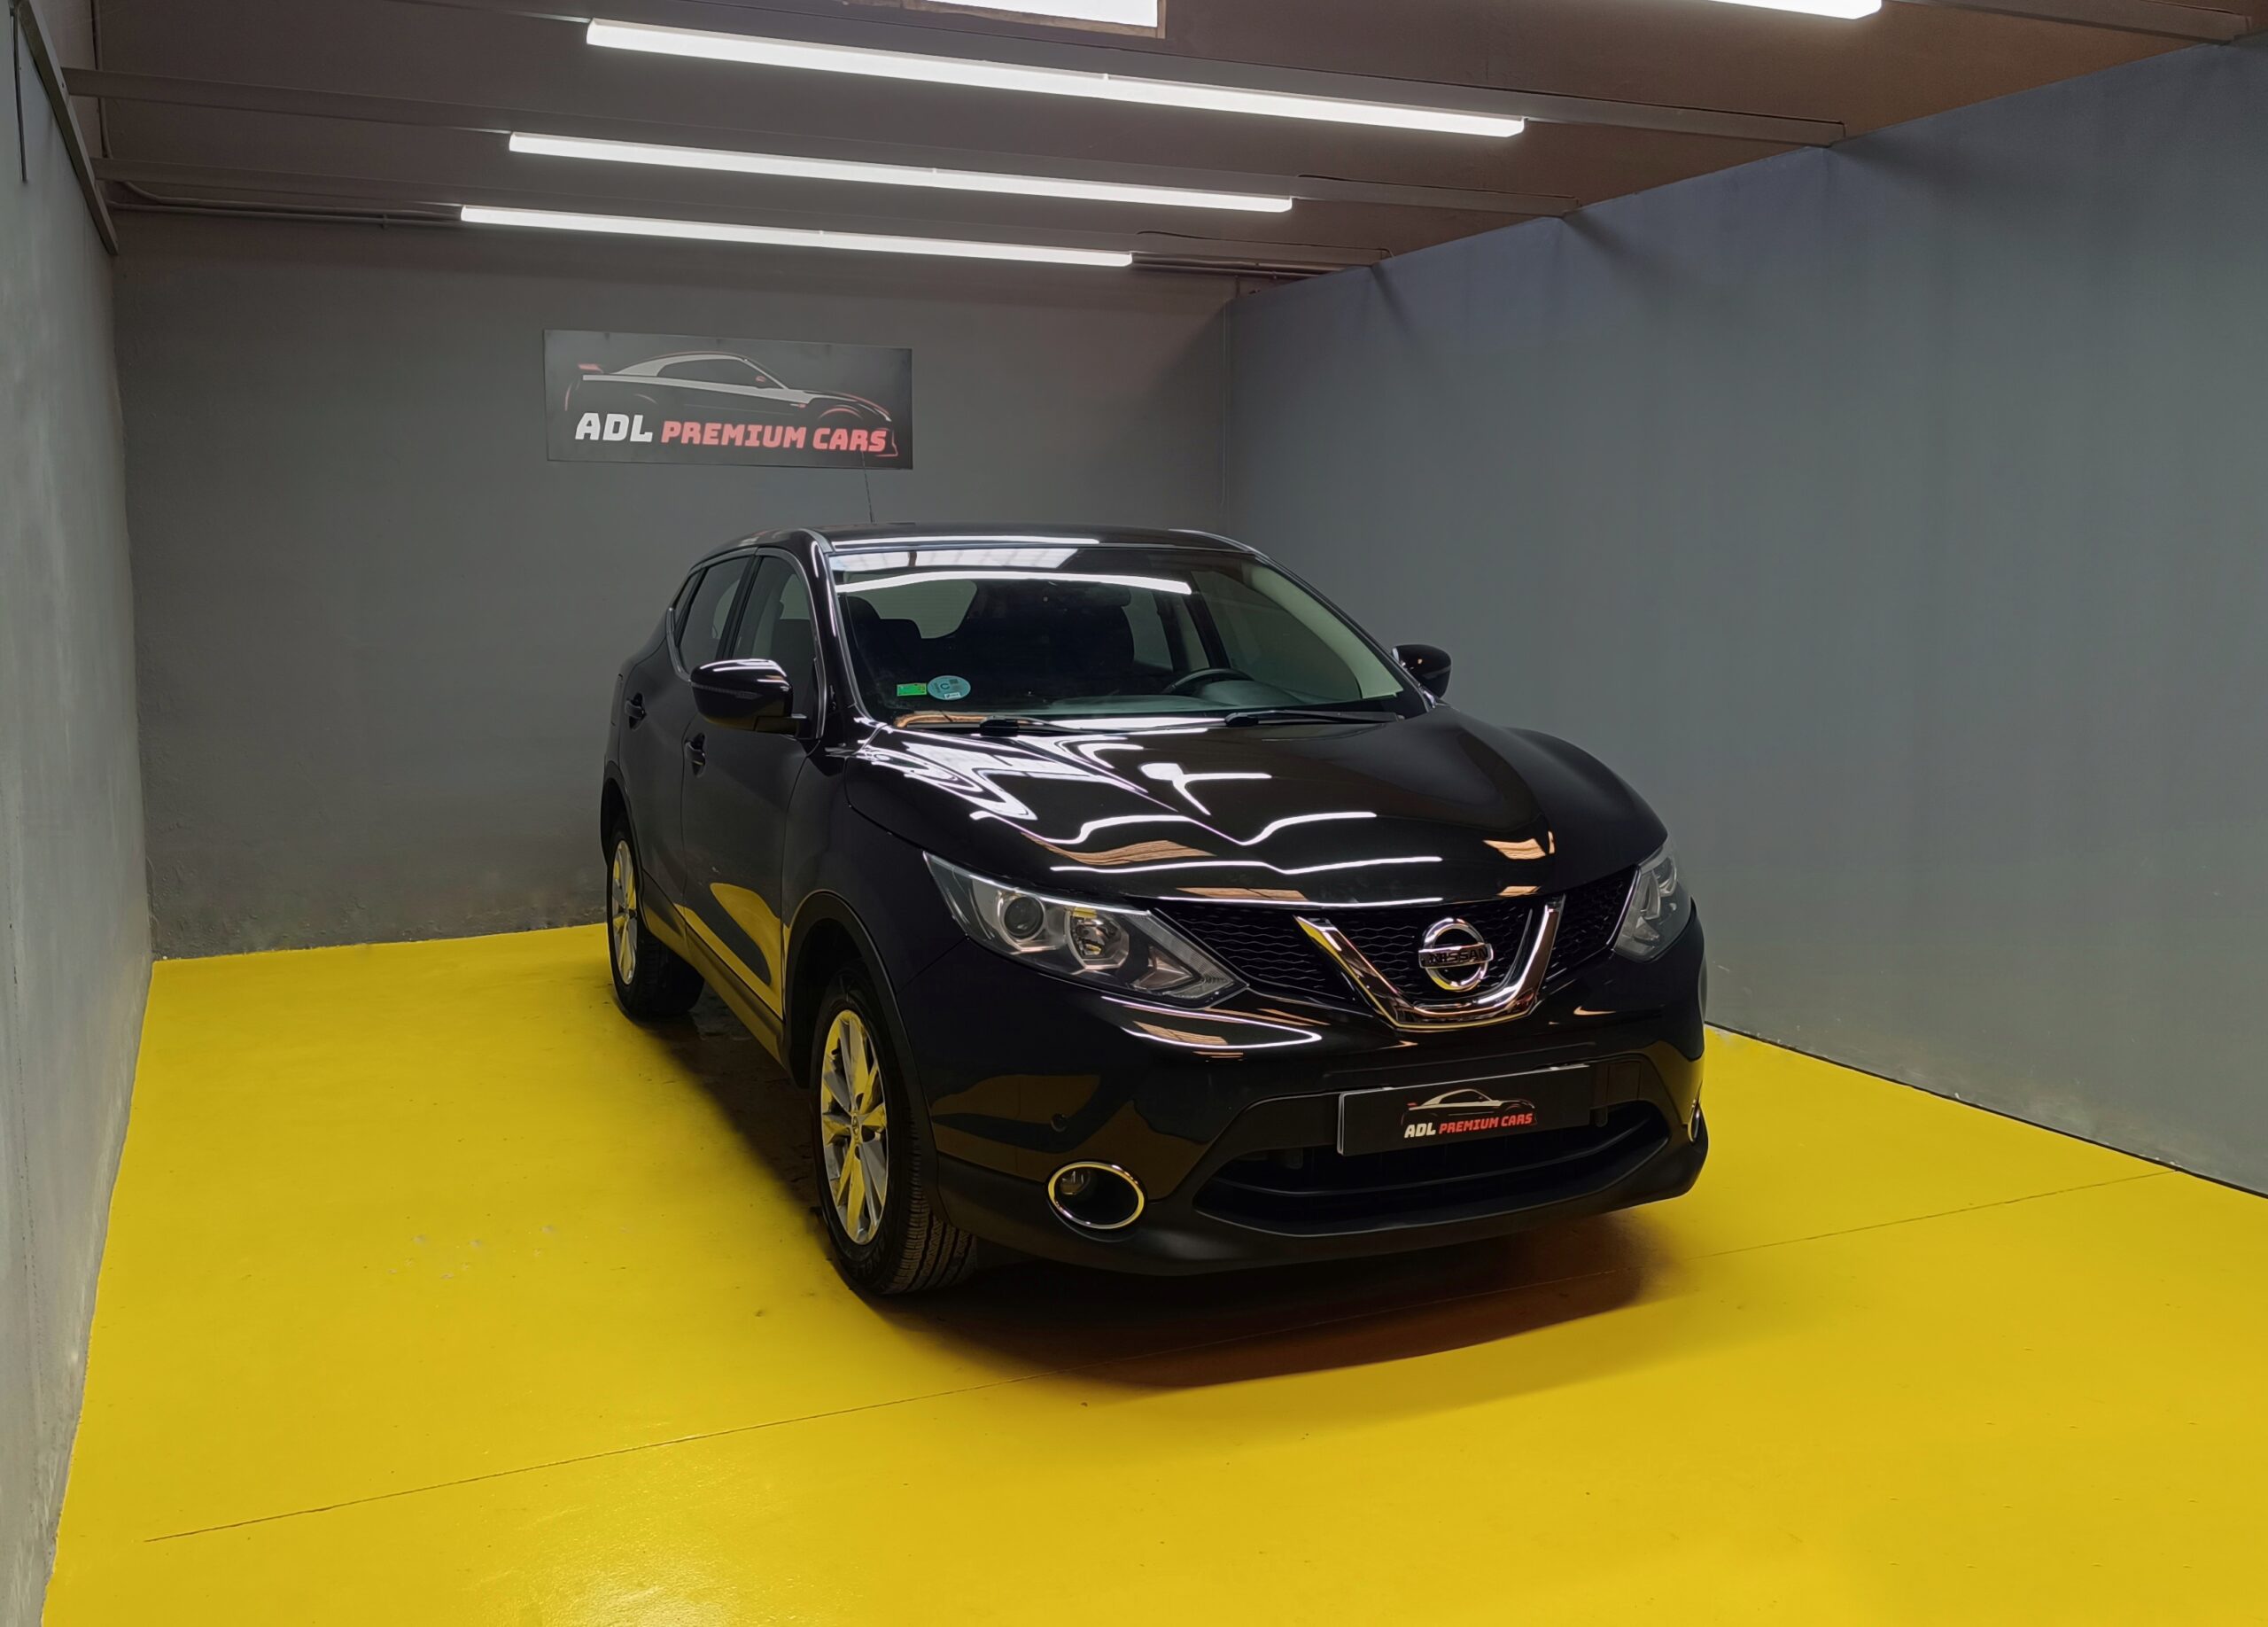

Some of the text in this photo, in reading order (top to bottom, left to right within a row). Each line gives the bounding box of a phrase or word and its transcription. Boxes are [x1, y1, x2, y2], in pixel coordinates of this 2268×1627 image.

[575, 412, 887, 453] ADL PREMIUM CARS
[1427, 947, 1487, 964] NISSAN
[1404, 1113, 1533, 1139] ADL PREMIUM CARS
